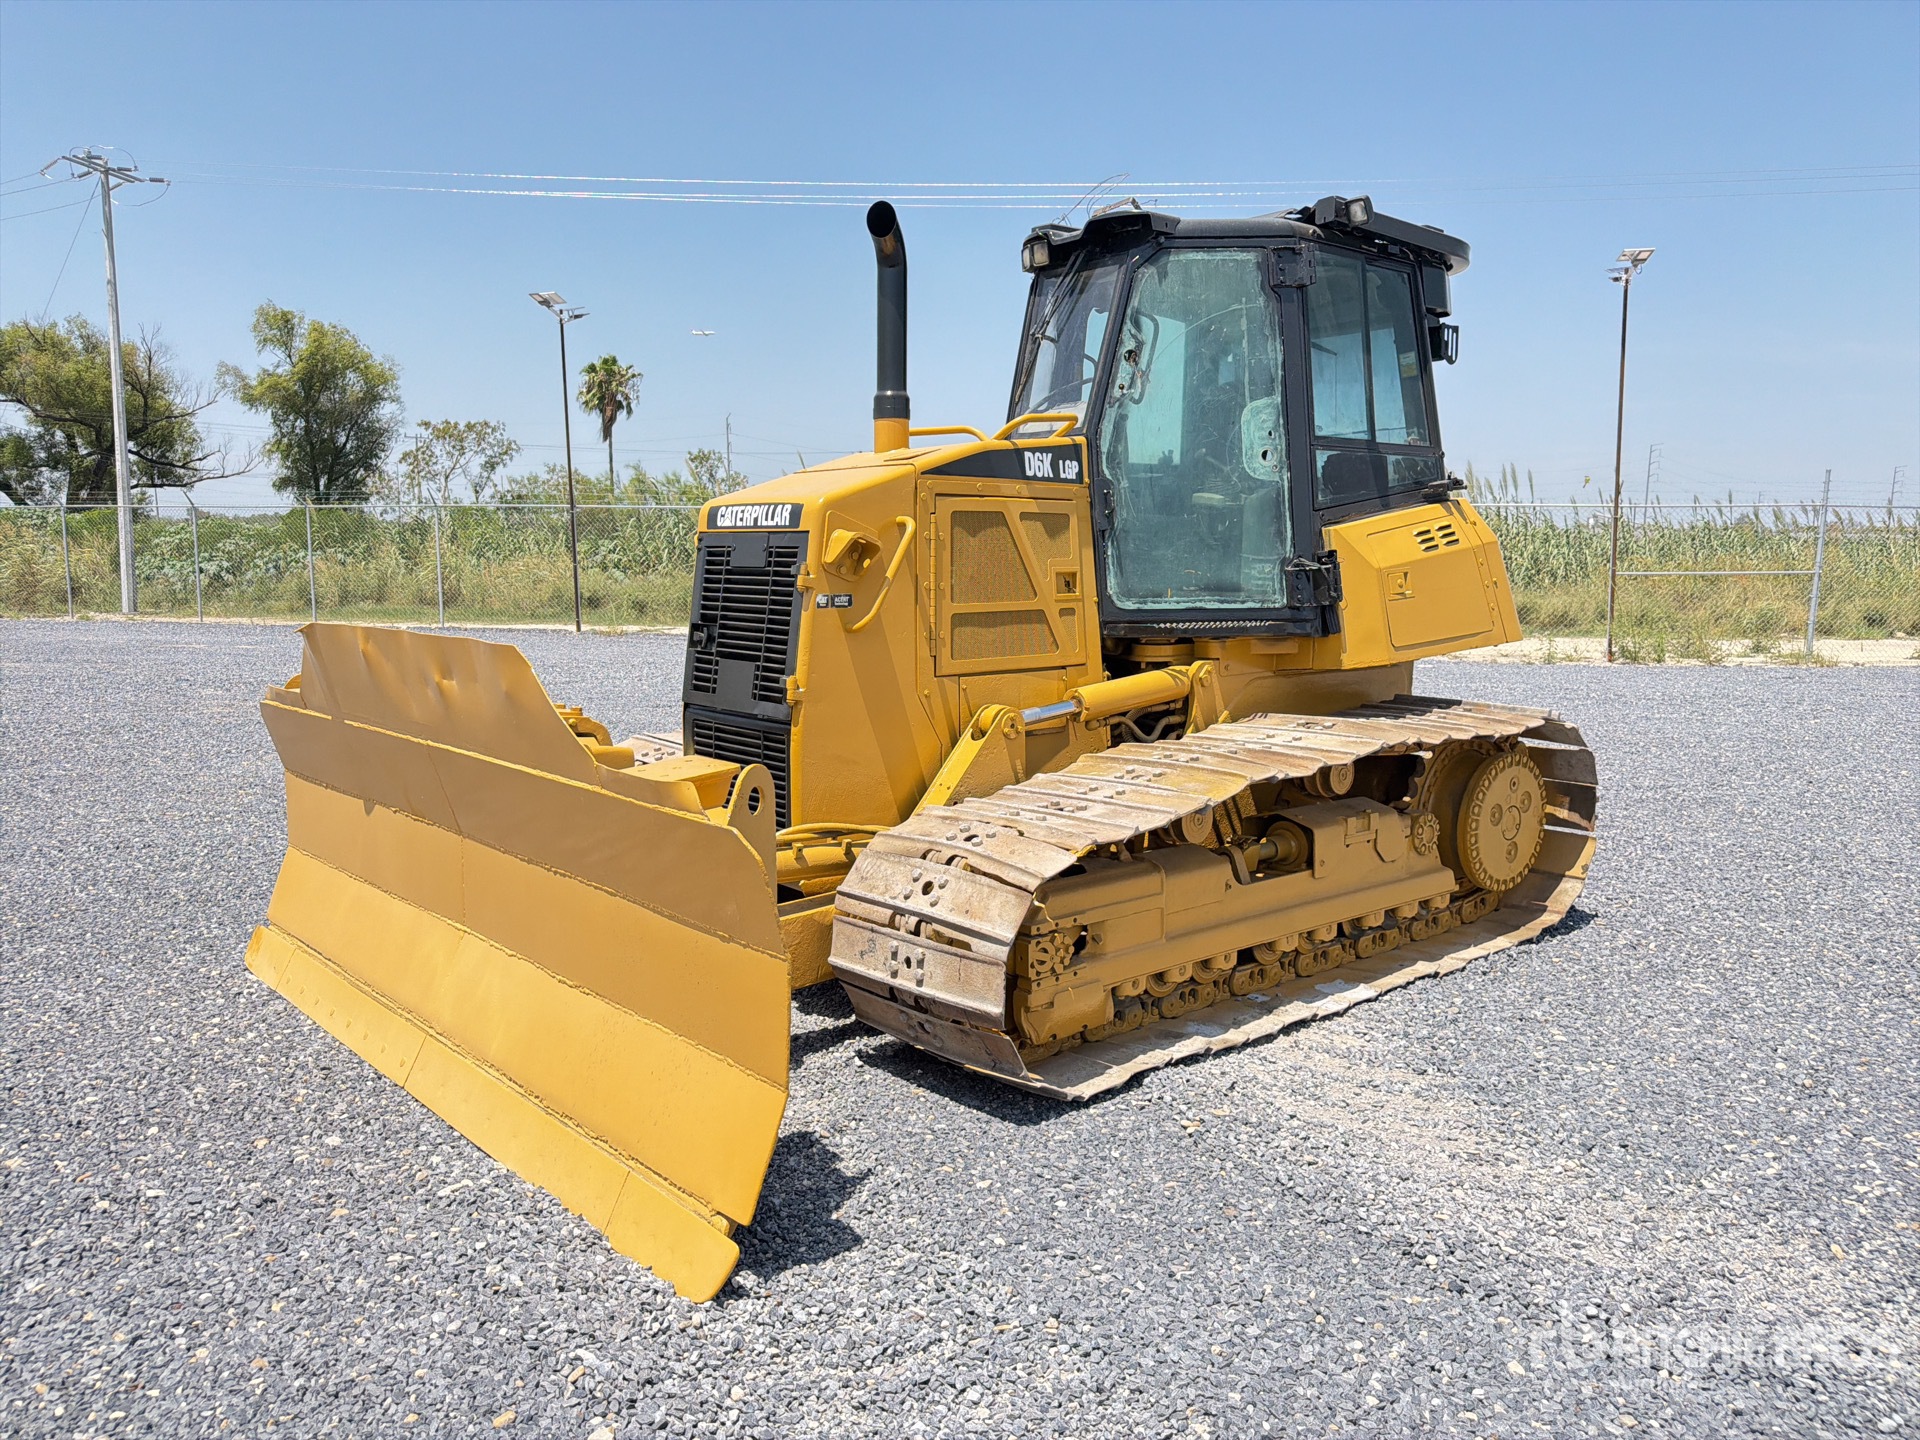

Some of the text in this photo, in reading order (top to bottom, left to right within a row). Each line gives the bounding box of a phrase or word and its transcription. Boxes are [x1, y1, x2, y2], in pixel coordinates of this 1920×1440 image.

[1024, 451, 1079, 479] D6K LGP
[716, 504, 792, 527] CATERPILLAR
